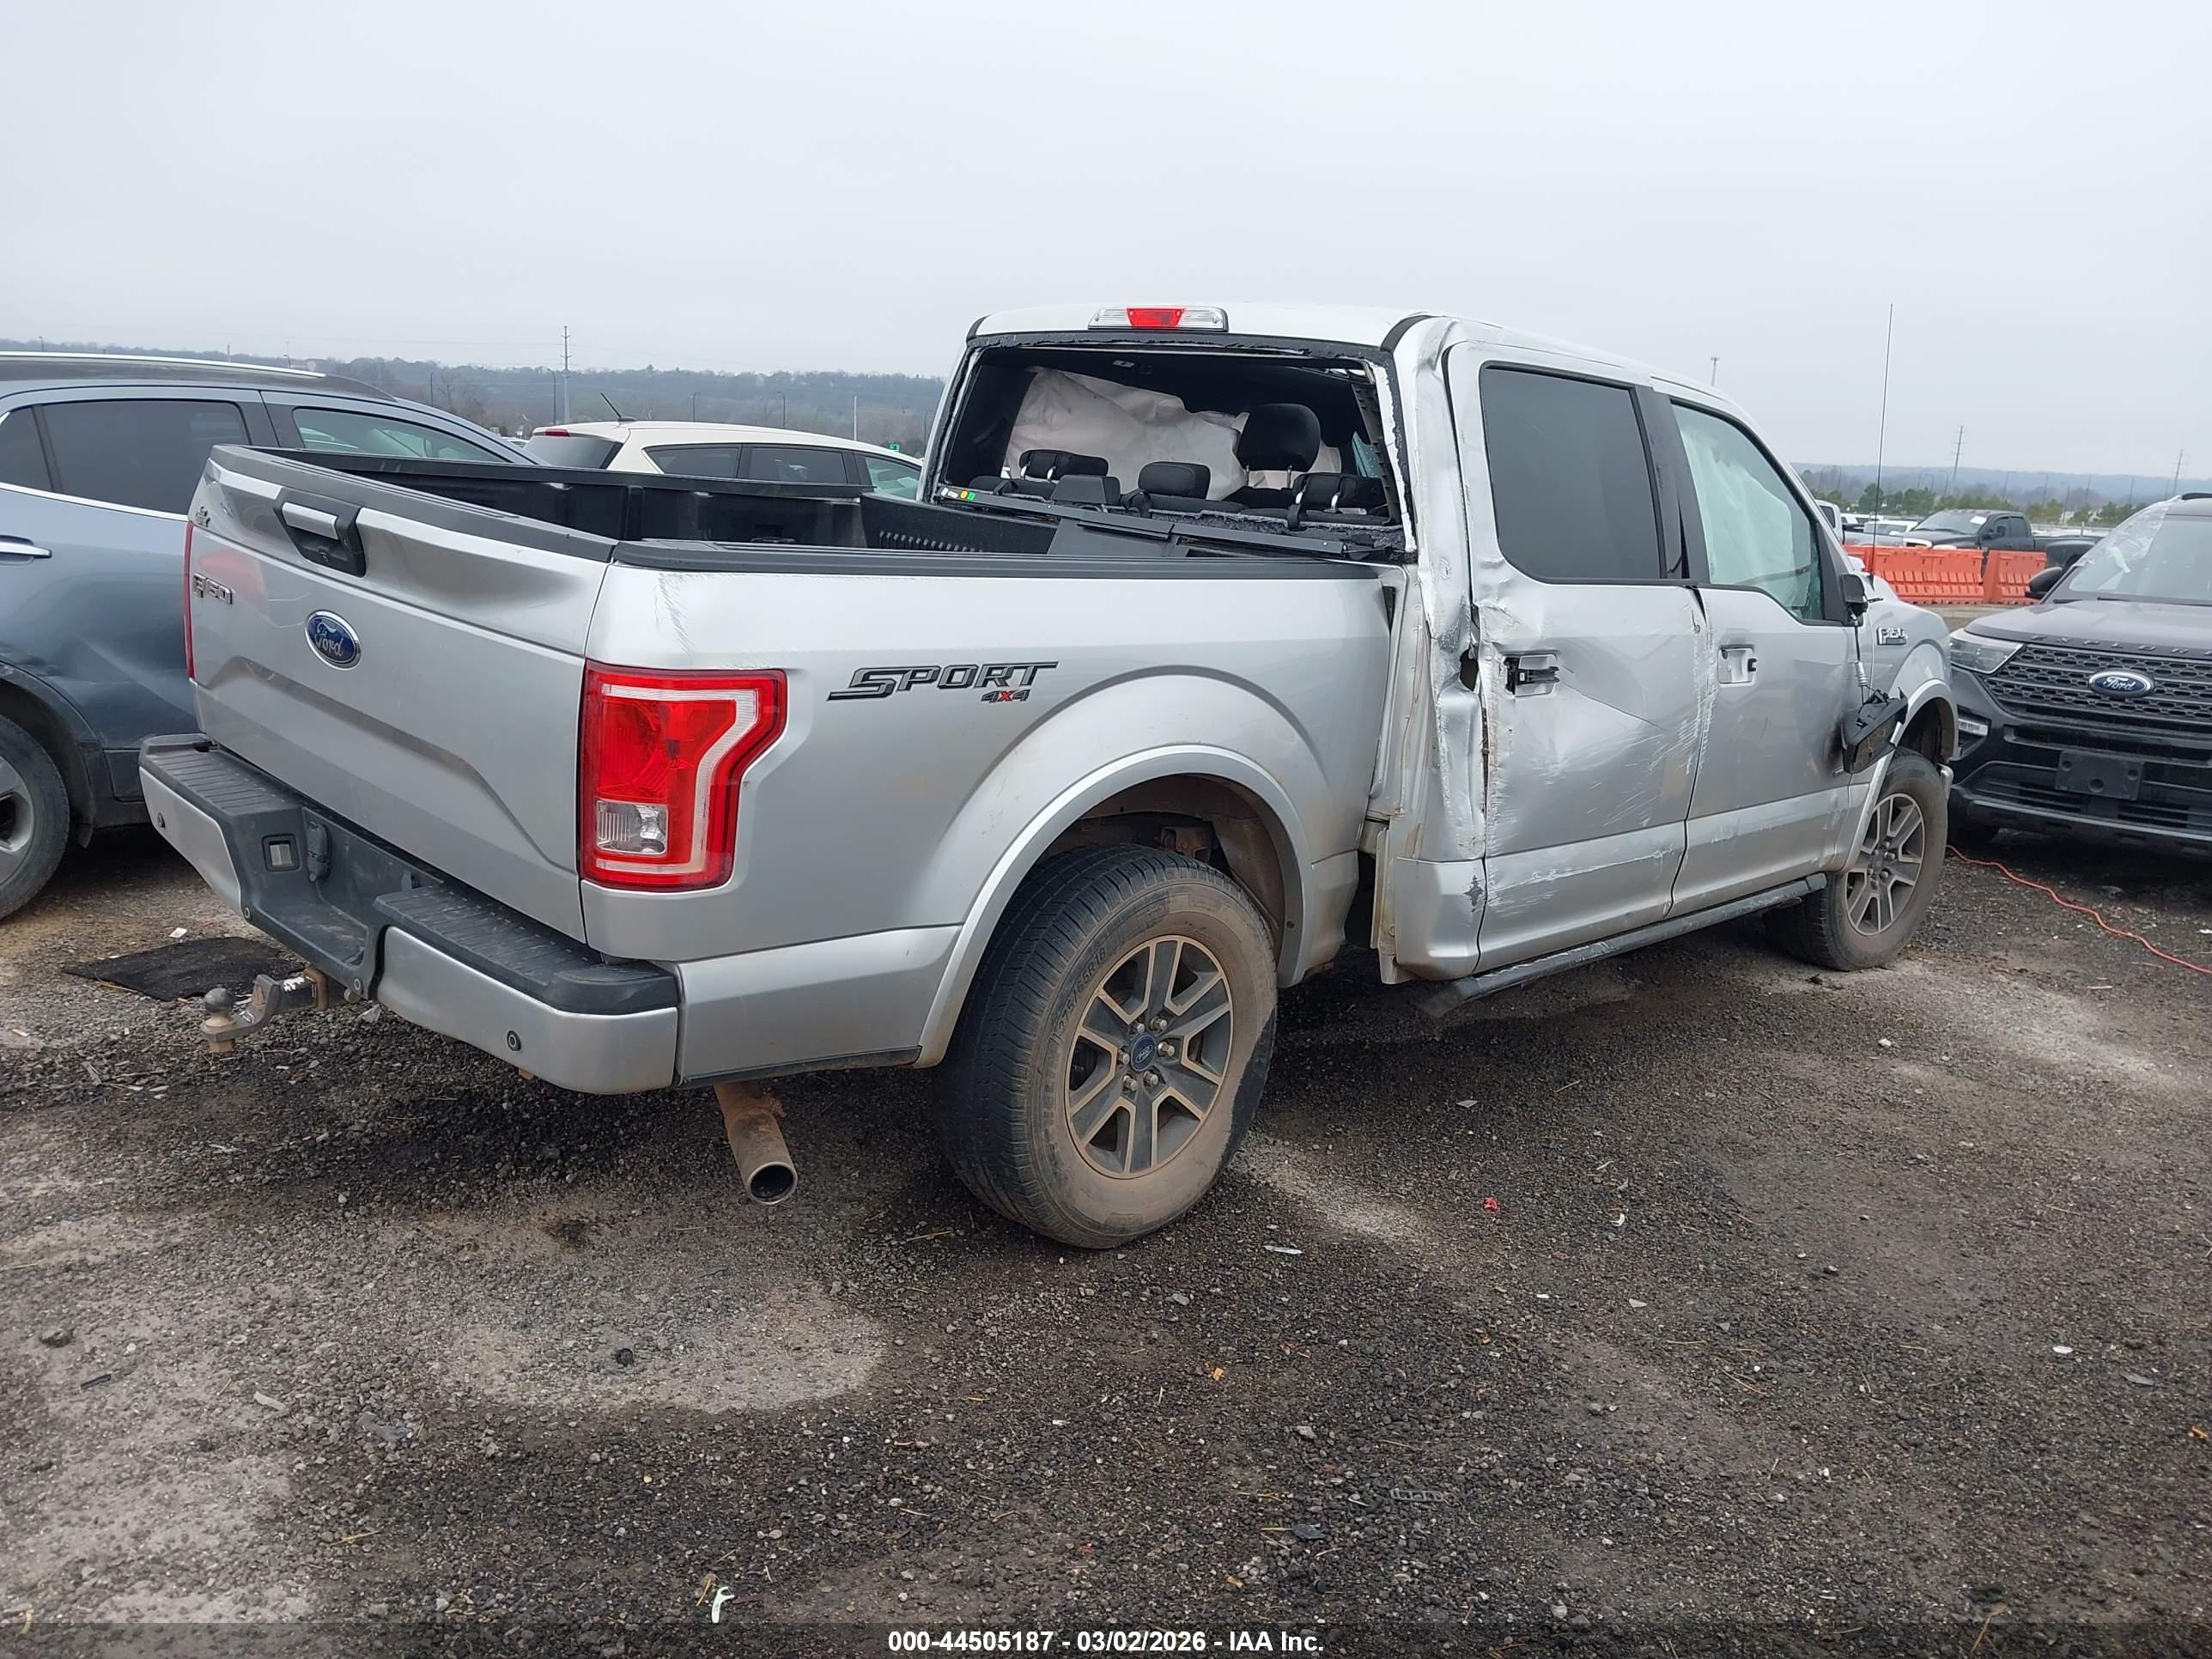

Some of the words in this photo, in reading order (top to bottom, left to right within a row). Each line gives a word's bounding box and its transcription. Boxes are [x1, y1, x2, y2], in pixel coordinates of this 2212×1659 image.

[314, 622, 344, 657] Ford
[826, 661, 1059, 702] SPORT
[2104, 676, 2136, 691] Ford
